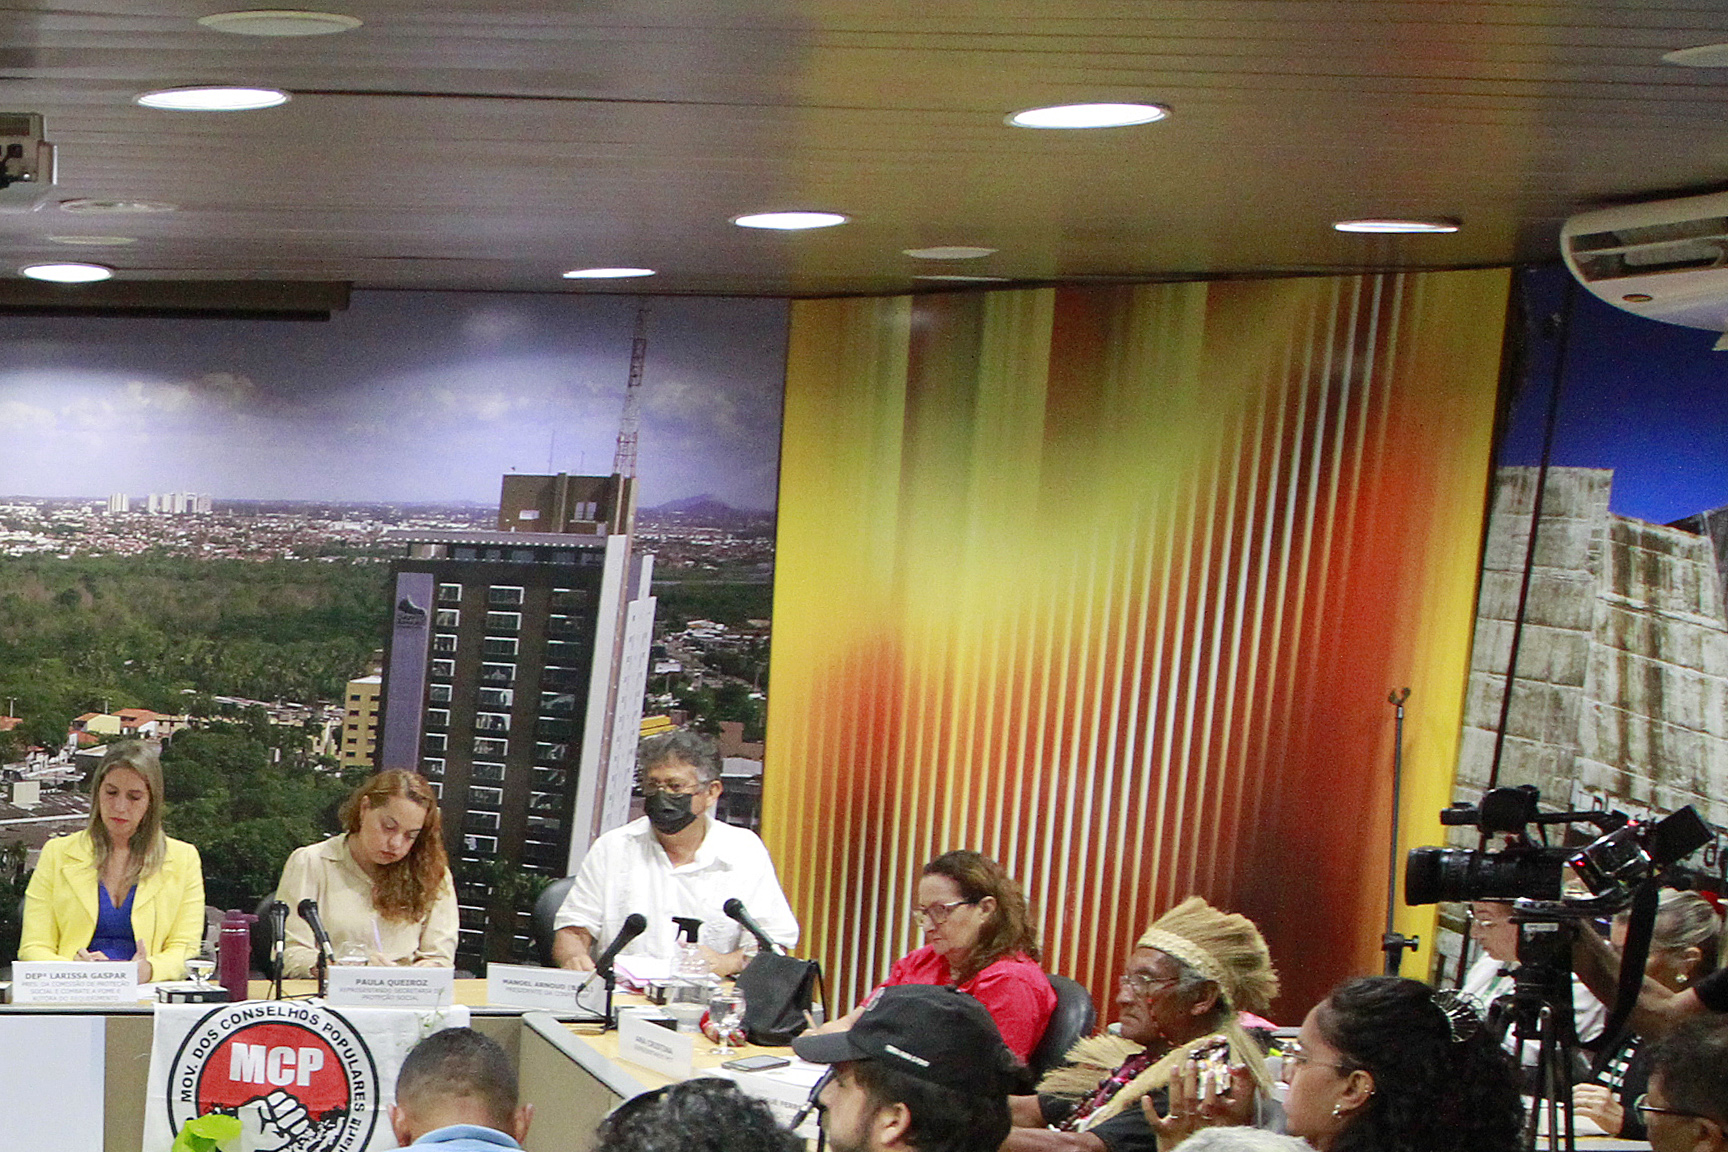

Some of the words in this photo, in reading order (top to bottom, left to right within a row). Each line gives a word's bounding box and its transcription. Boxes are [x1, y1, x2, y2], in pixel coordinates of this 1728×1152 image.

[355, 978, 384, 986] PAULA
[387, 978, 428, 987] QUEIROZ
[181, 1065, 198, 1102] MOV.
[193, 1029, 219, 1060] DOS
[220, 1006, 320, 1030] CONSELHOS
[322, 1022, 366, 1112] POPULARES
[229, 1042, 324, 1086] MCP
